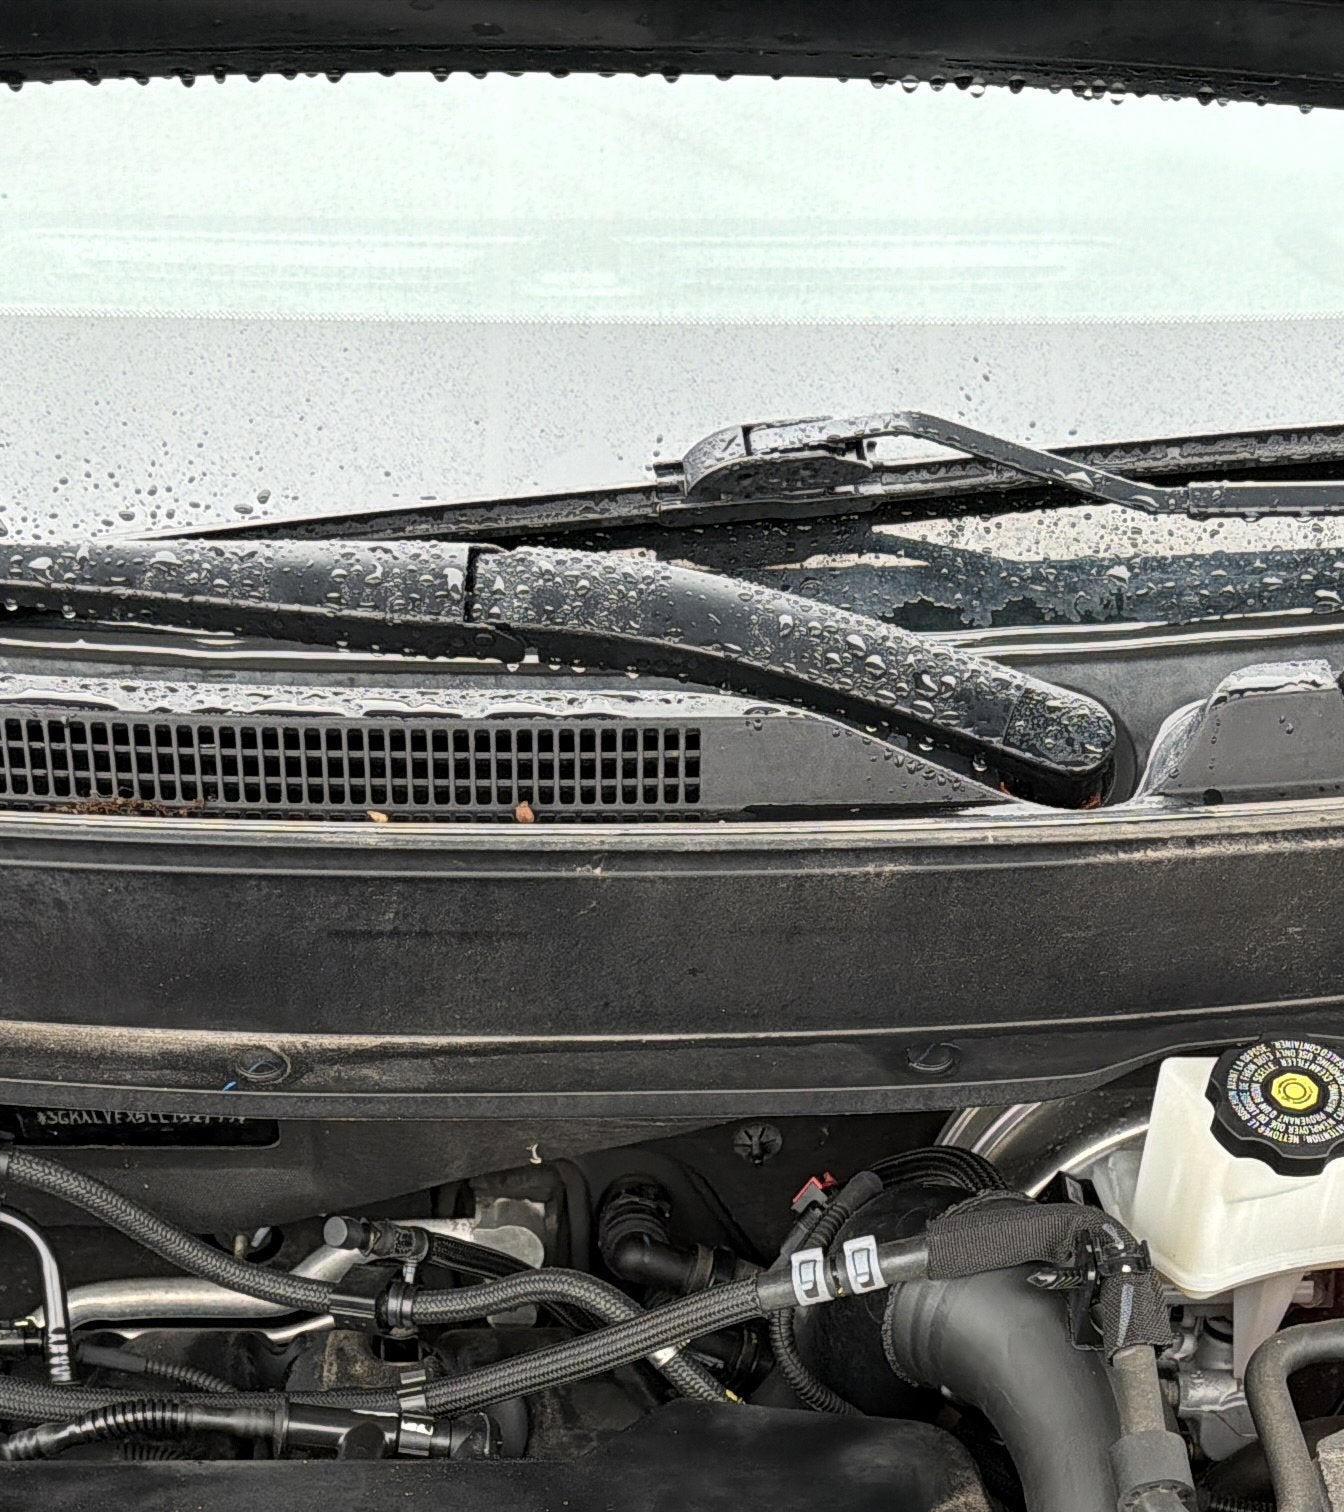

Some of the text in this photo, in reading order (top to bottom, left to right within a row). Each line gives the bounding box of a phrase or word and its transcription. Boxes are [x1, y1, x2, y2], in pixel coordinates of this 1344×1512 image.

[1275, 1049, 1297, 1058] ONLY
[1297, 1050, 1314, 1061] USE
[1233, 1060, 1245, 1070] LA
[1280, 1058, 1310, 1069] FILLER
[1309, 1063, 1334, 1082] CLEAN
[1247, 1118, 1260, 1129] LE
[1277, 1111, 1327, 1126] PROVENANT
[1269, 1120, 1286, 1132] QUE
[1258, 1125, 1300, 1144] NETTOYER
